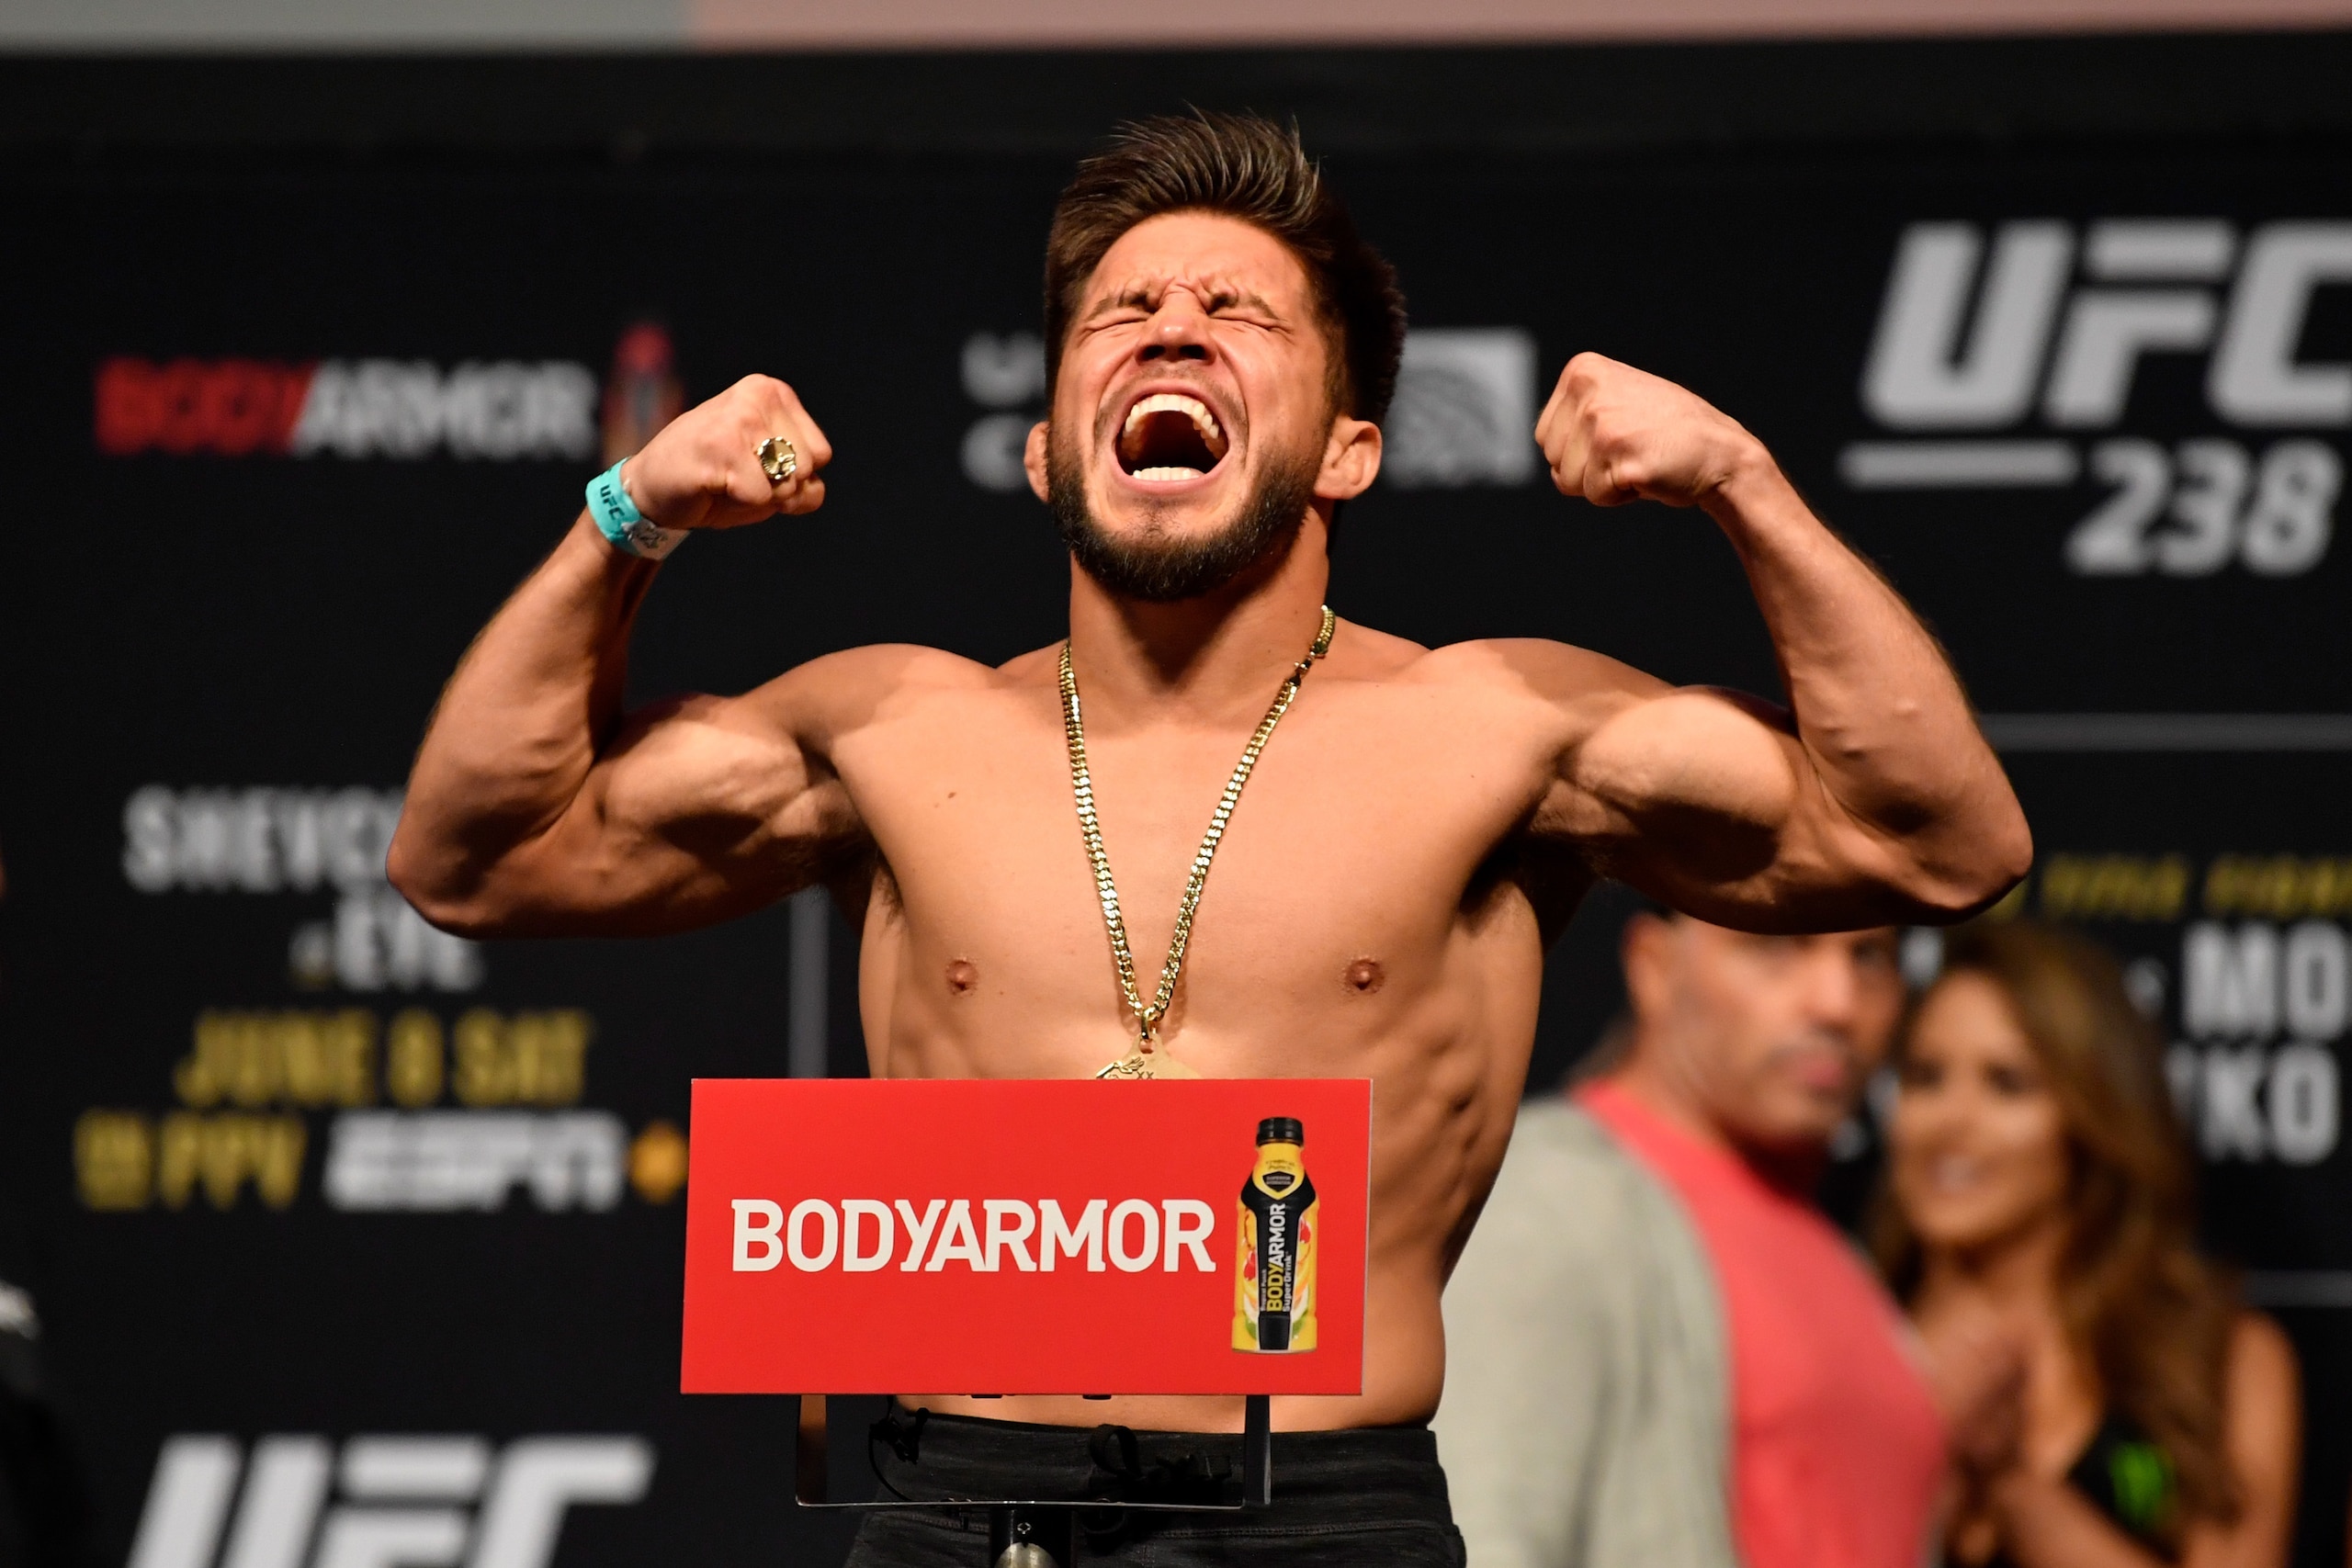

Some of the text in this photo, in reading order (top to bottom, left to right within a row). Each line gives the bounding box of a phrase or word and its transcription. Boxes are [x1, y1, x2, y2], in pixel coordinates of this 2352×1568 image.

[1861, 220, 2352, 430] UFC
[96, 356, 596, 457] BODYARMOR
[599, 483, 626, 521] UFC
[2067, 439, 2344, 576] 238
[731, 1198, 1216, 1274] BODYARMOR
[1266, 1203, 1286, 1313] BODYARMOR
